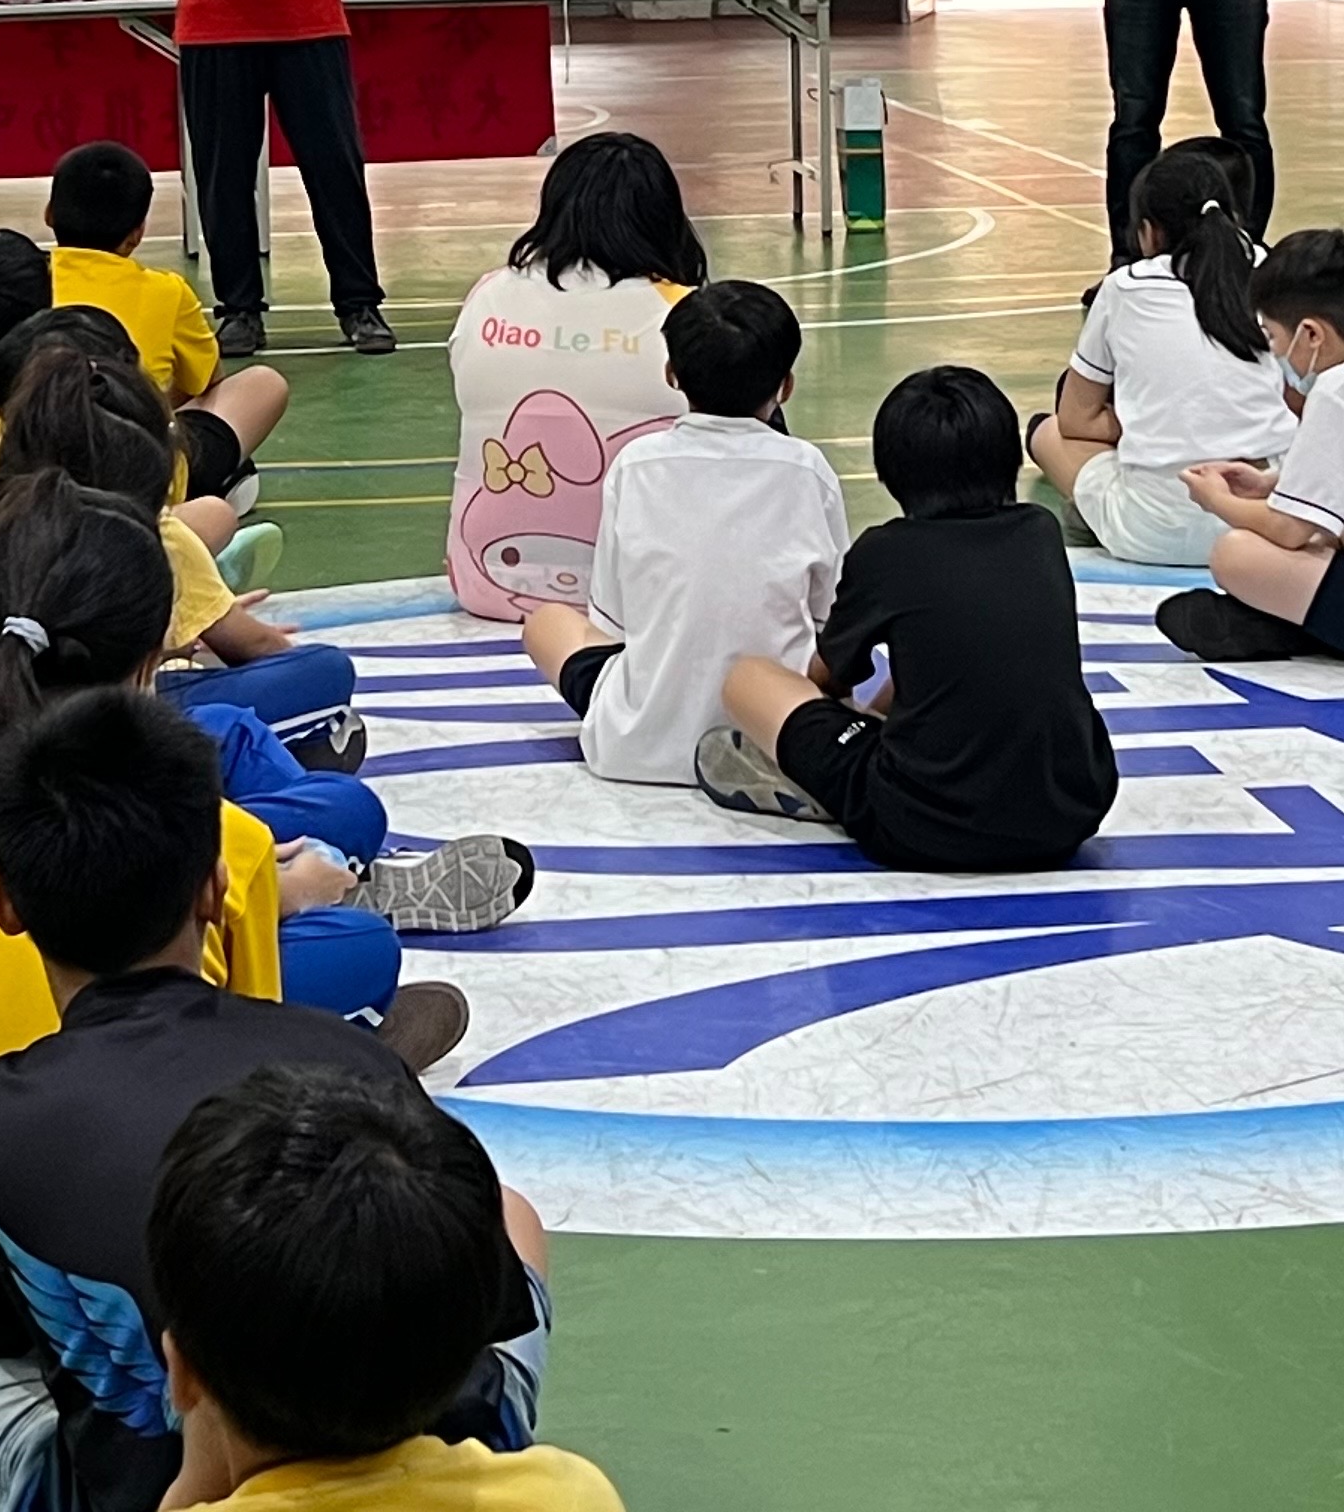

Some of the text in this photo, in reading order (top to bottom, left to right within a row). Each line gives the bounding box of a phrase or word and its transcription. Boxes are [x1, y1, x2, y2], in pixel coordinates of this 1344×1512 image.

[481, 316, 640, 355] Qiao Le Fu
